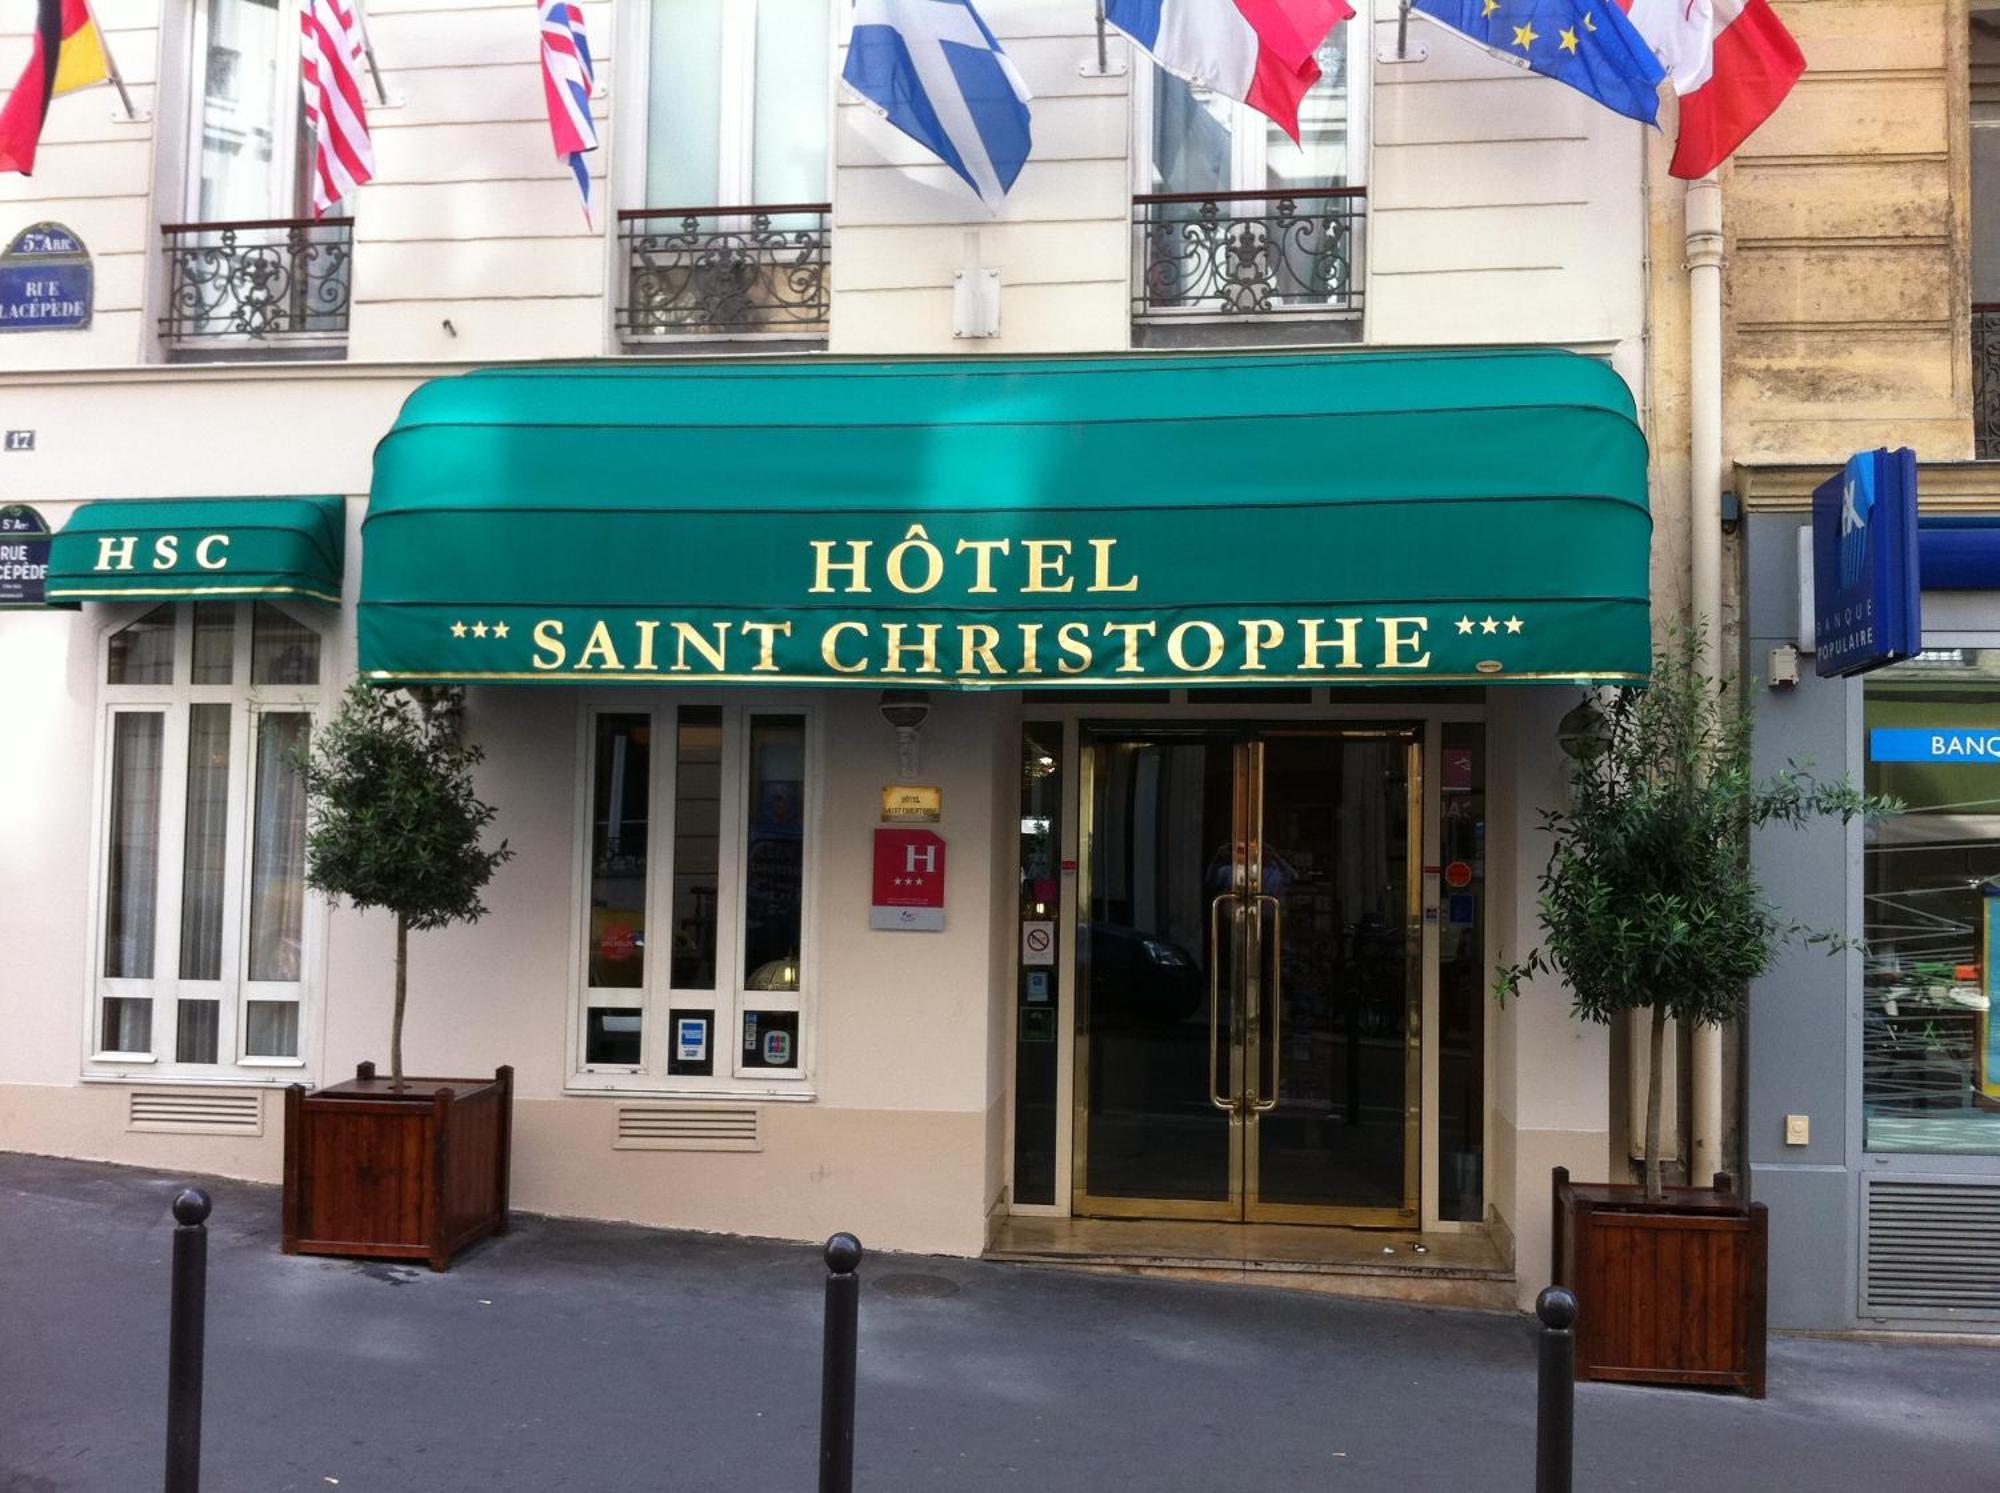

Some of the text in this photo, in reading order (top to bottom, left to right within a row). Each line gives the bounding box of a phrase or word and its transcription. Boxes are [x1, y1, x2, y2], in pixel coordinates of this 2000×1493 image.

[25, 281, 59, 297] RUE
[0, 298, 85, 319] LACÉPÈDE
[11, 432, 30, 449] 17
[0, 545, 28, 561] RUE
[808, 523, 1138, 594] HÔTEL
[1816, 598, 1873, 637] BANQUE
[532, 616, 1431, 674] SAINT CHRISTOPHE
[1817, 626, 1873, 663] POPULAIRE
[906, 844, 936, 873] H
